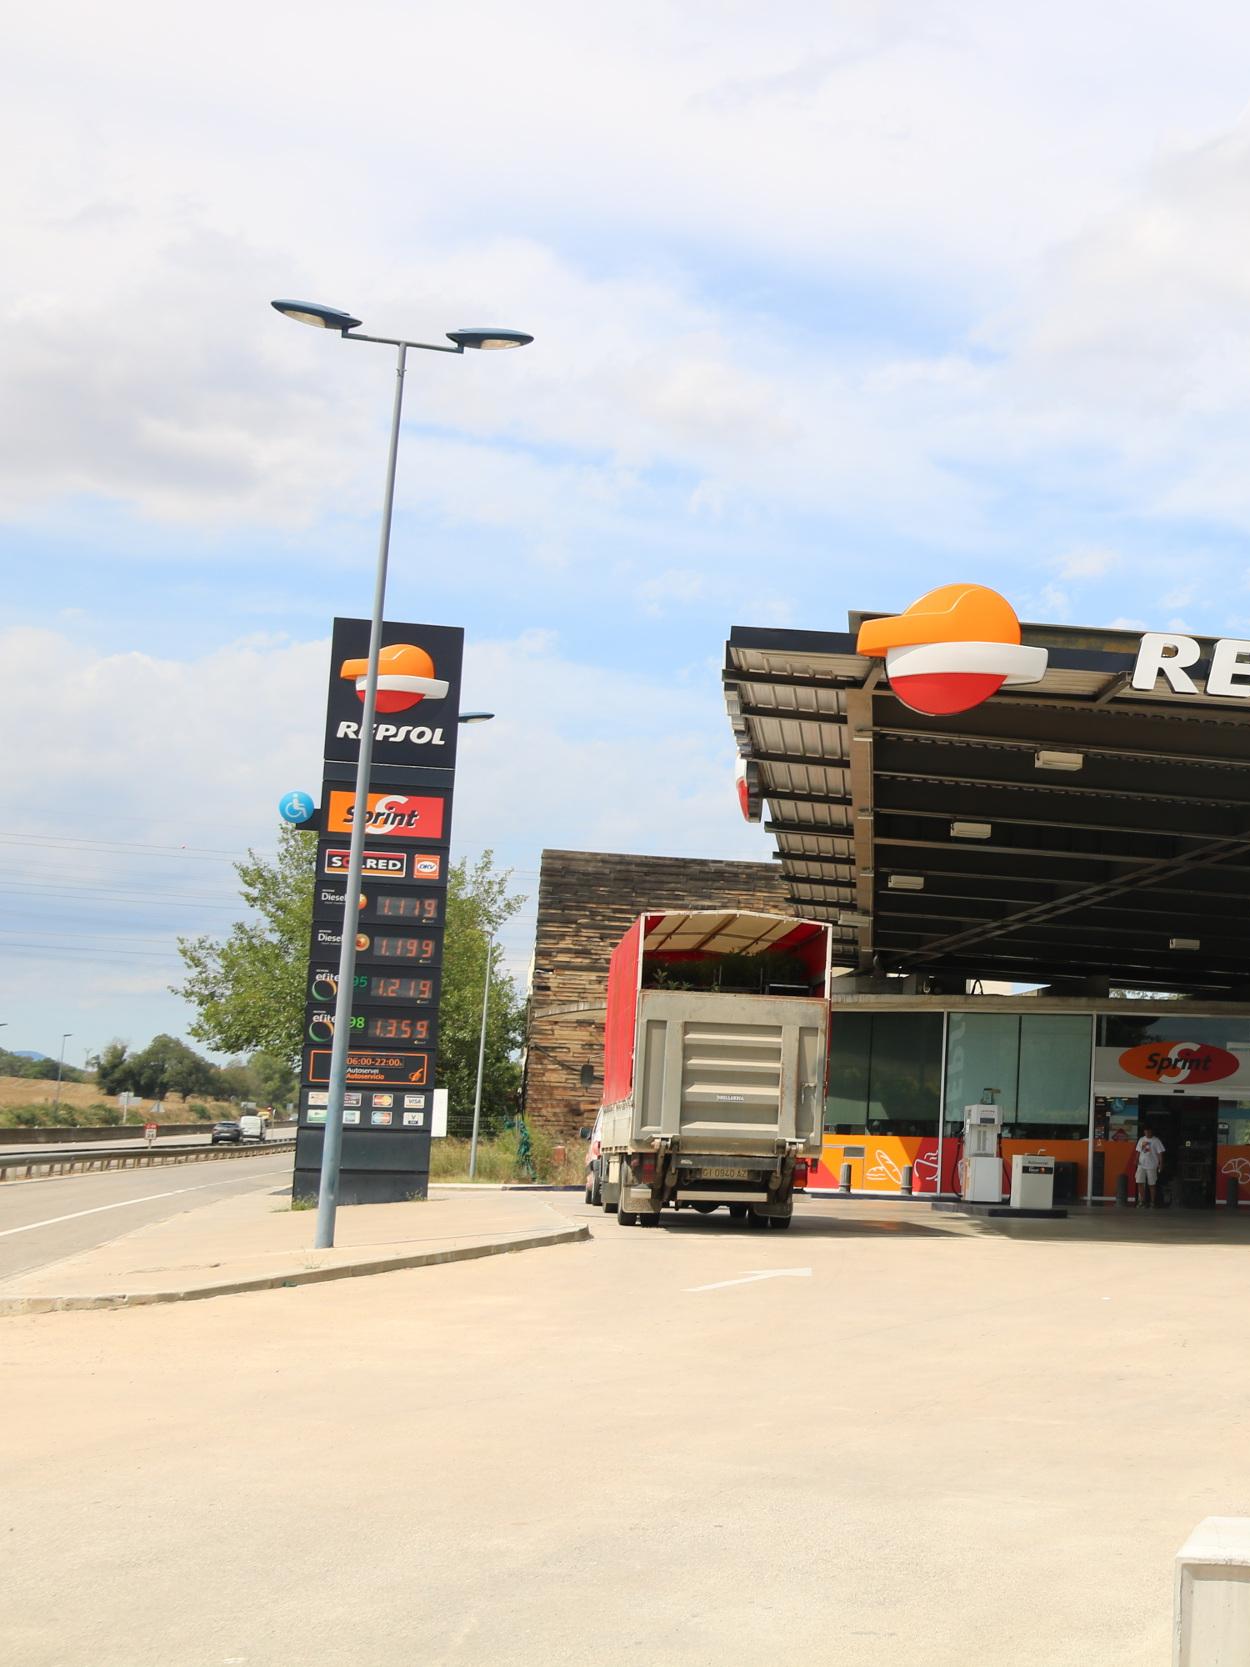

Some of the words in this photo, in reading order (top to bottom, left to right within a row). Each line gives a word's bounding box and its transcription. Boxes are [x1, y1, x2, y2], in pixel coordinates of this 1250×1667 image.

[381, 939, 433, 957] 1.199
[378, 979, 431, 998] 1.219
[374, 1019, 429, 1038] 1.359
[1146, 1053, 1213, 1074] Sprint
